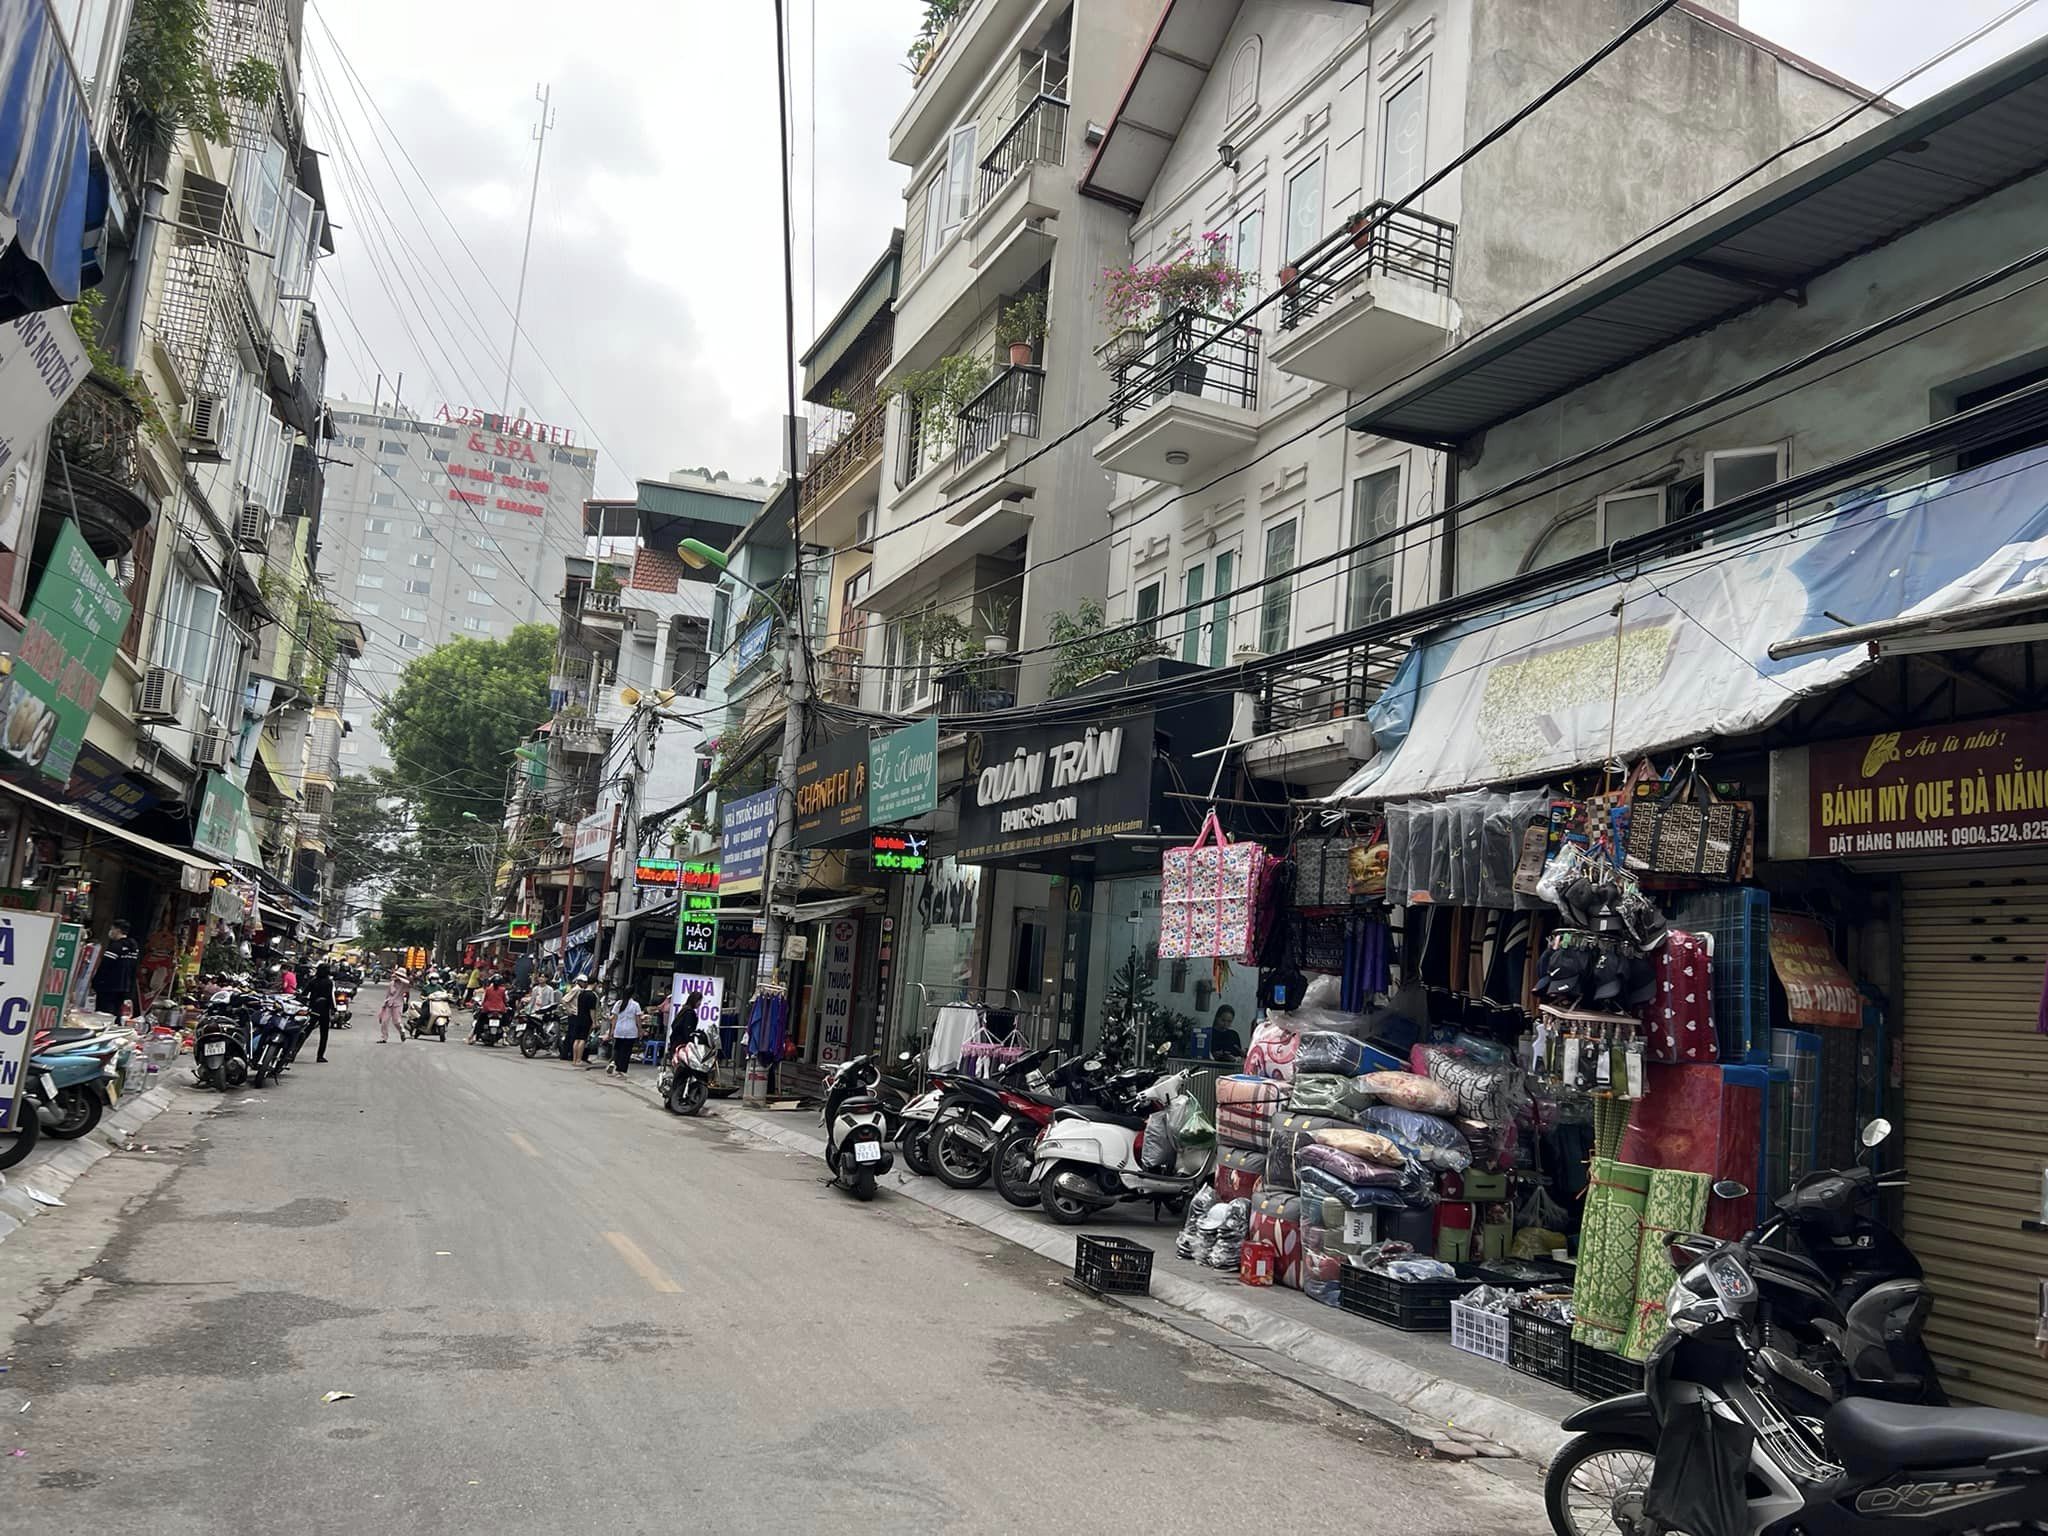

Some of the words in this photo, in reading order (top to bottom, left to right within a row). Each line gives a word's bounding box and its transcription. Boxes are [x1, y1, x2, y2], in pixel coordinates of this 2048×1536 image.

[490, 413, 577, 448] HOTEL
[467, 432, 486, 453] &
[494, 437, 537, 464] SPA
[1943, 735, 1960, 753] là
[977, 746, 1047, 807] QUÂN
[1049, 720, 1123, 788] TRẦN
[1822, 783, 1873, 827] BÁNH
[1878, 776, 1909, 823] MỲ
[1914, 780, 1955, 823] QUE
[1960, 768, 1990, 816] ĐÀ
[1000, 806, 1031, 833] HAIR
[1031, 796, 1078, 827] SALON
[1829, 834, 1853, 857] ĐẶT
[1856, 830, 1892, 851] HÀNG
[1896, 828, 1948, 849] NHANH:
[875, 851, 901, 867] TÓC
[686, 923, 712, 937] HẢO
[681, 977, 715, 997] NHÀ
[673, 999, 720, 1022] TỐC
[1352, 1218, 1360, 1237] MUJI
